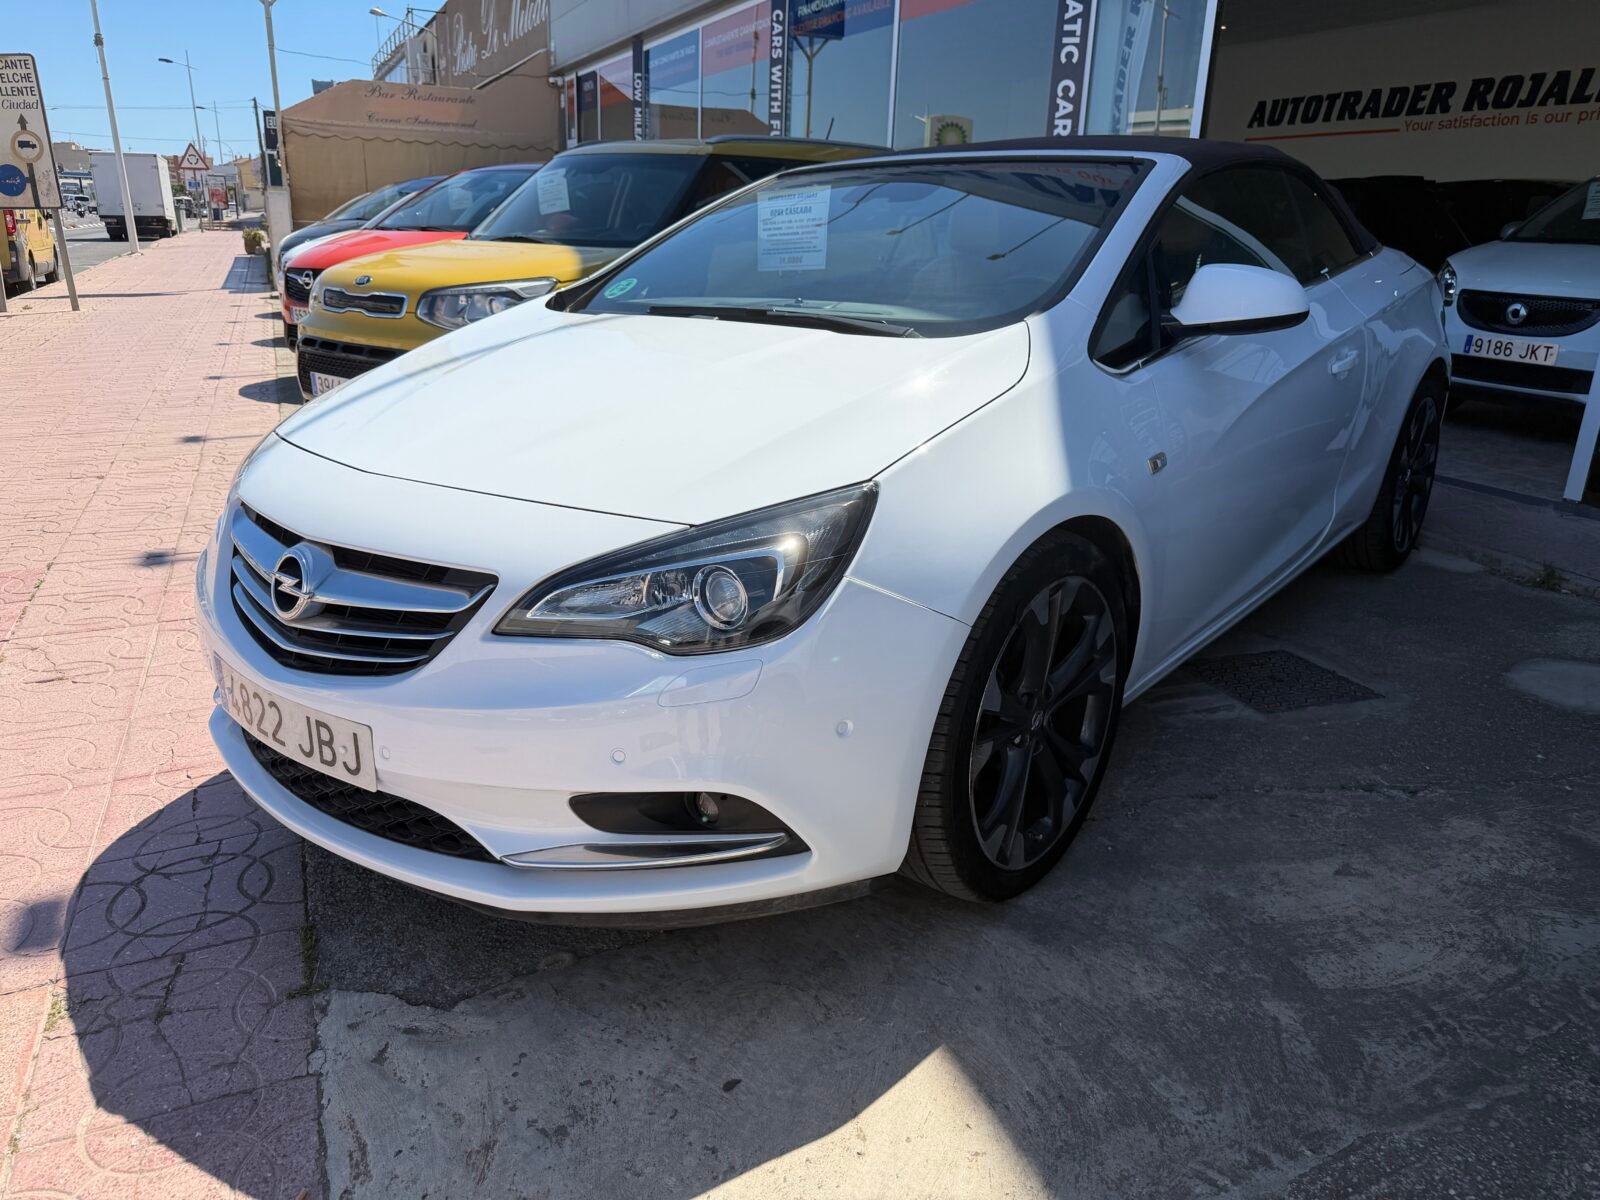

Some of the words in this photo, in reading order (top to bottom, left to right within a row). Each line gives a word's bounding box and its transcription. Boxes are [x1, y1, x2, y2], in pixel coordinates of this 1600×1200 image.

[771, 9, 784, 59] CARS
[1060, 0, 1084, 65] ATIC
[0, 73, 34, 84] ELCHE
[634, 72, 642, 102] LOW
[770, 65, 783, 114] WITH
[2, 99, 39, 110] Ciudad
[364, 85, 396, 99] Bar
[401, 87, 476, 104] Restaurante
[1053, 79, 1076, 136] CAR
[1247, 81, 1457, 128] AUTOTRADER
[1462, 67, 1600, 112] ROJAL
[367, 111, 401, 124] Cocina
[406, 115, 478, 128] Internacional
[1404, 118, 1434, 132] Your
[1438, 112, 1519, 129] satisfaction
[1526, 110, 1538, 125] is
[1544, 111, 1573, 124] our
[1473, 338, 1514, 358] 9186
[1519, 344, 1554, 362] JKT
[228, 674, 286, 747] 4822
[297, 715, 361, 776] JBJ
